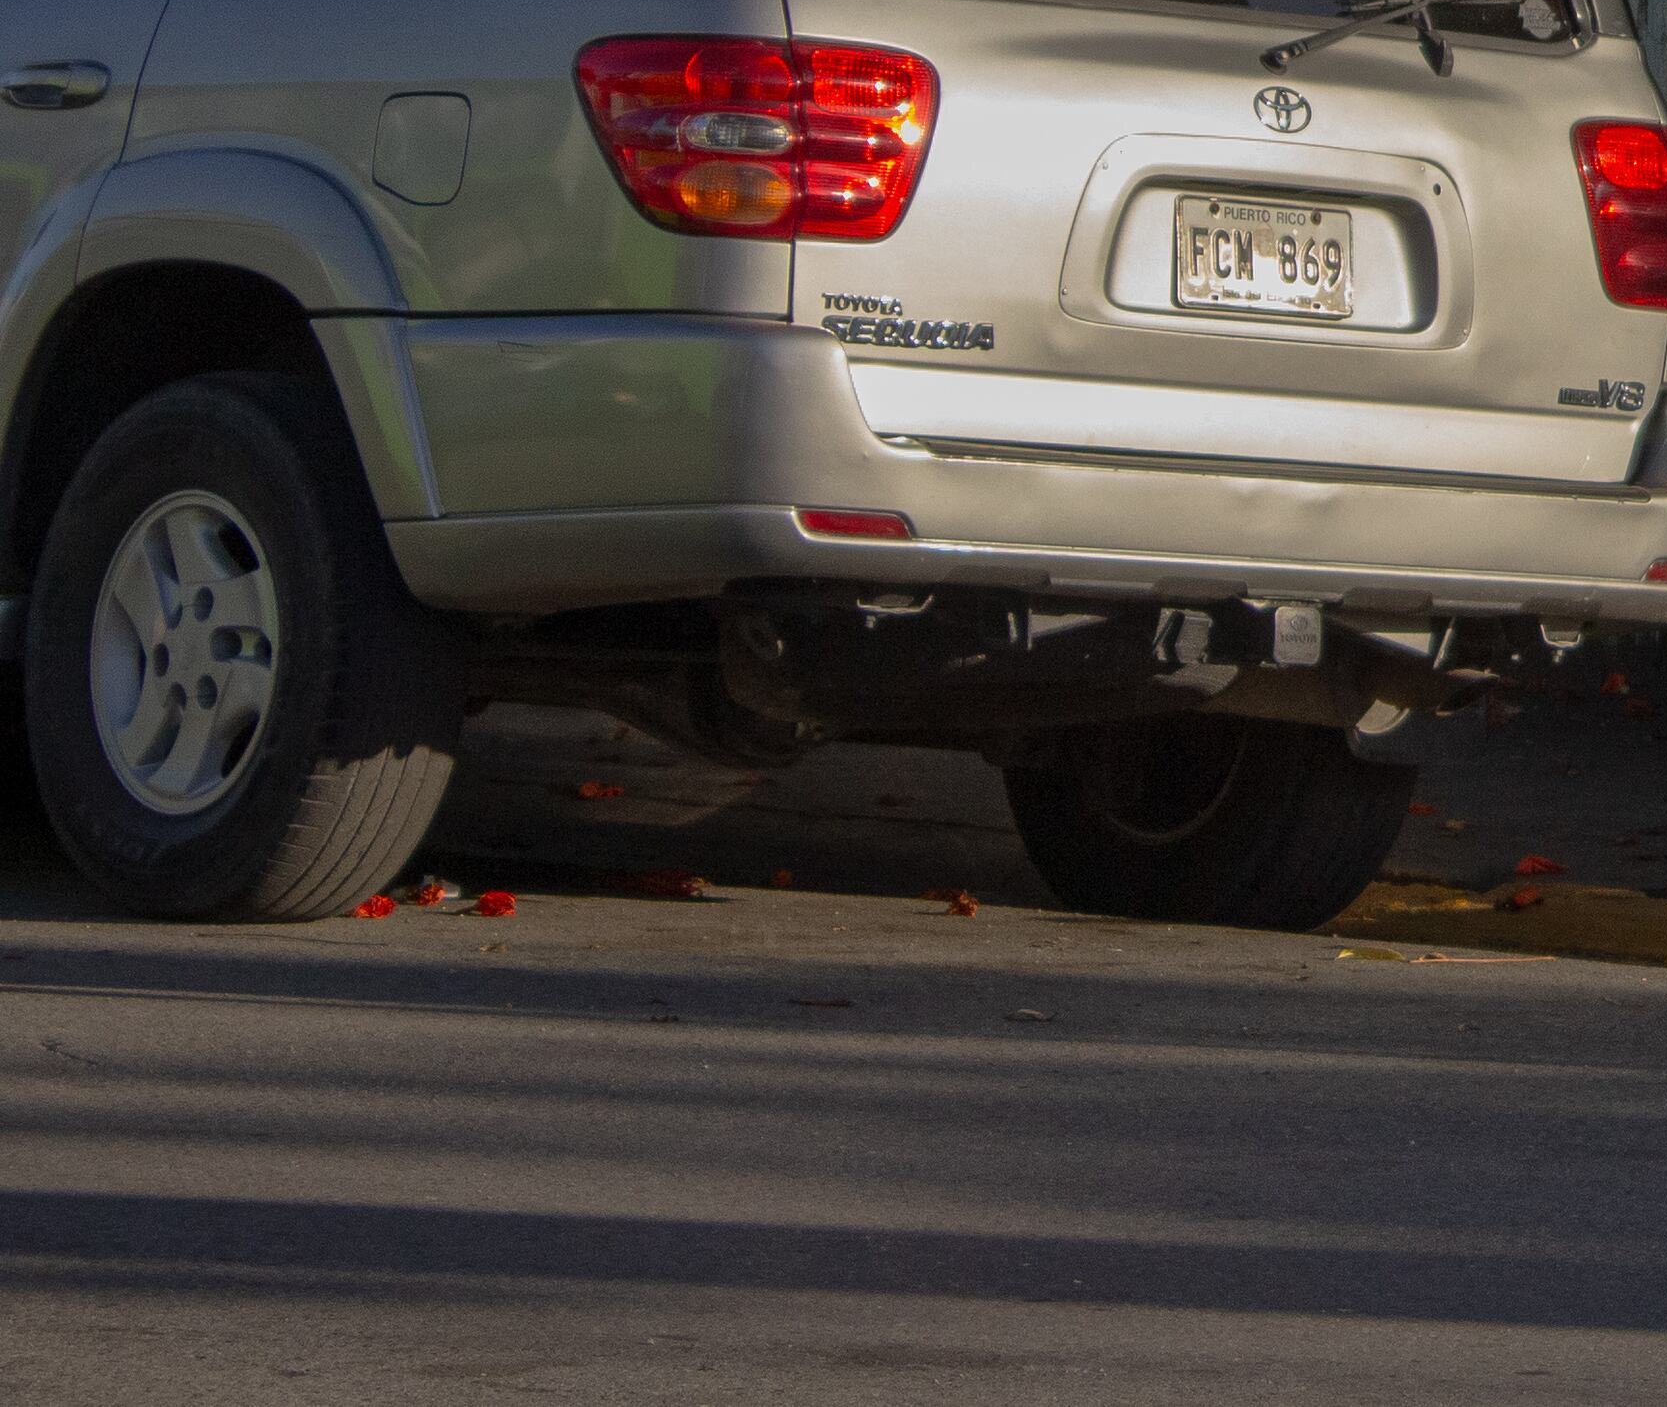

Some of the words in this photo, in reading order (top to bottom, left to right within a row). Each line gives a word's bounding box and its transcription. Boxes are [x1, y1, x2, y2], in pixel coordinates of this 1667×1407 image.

[1224, 206, 1272, 223] PUERTO
[1276, 211, 1307, 226] RICO
[1188, 226, 1255, 282] FCM
[1276, 235, 1344, 290] 869
[821, 293, 903, 316] TOYOTA
[821, 315, 994, 350] SEQUOIA
